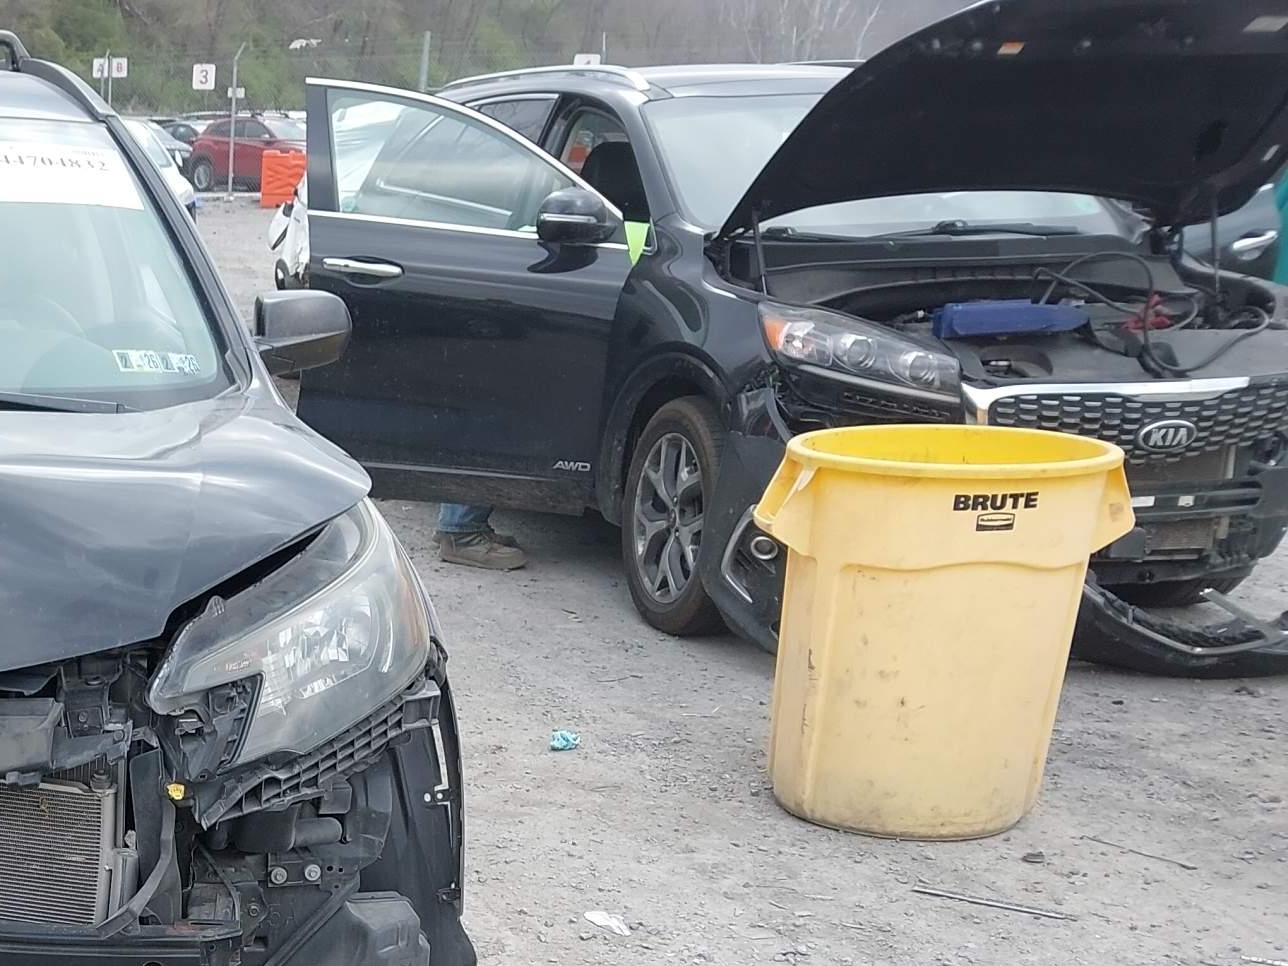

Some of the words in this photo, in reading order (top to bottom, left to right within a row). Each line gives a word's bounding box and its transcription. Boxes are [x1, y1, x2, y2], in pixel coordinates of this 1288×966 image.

[199, 69, 209, 85] 3
[1149, 427, 1188, 446] KIA
[553, 460, 591, 472] AWD
[953, 491, 1040, 511] BRUTE
